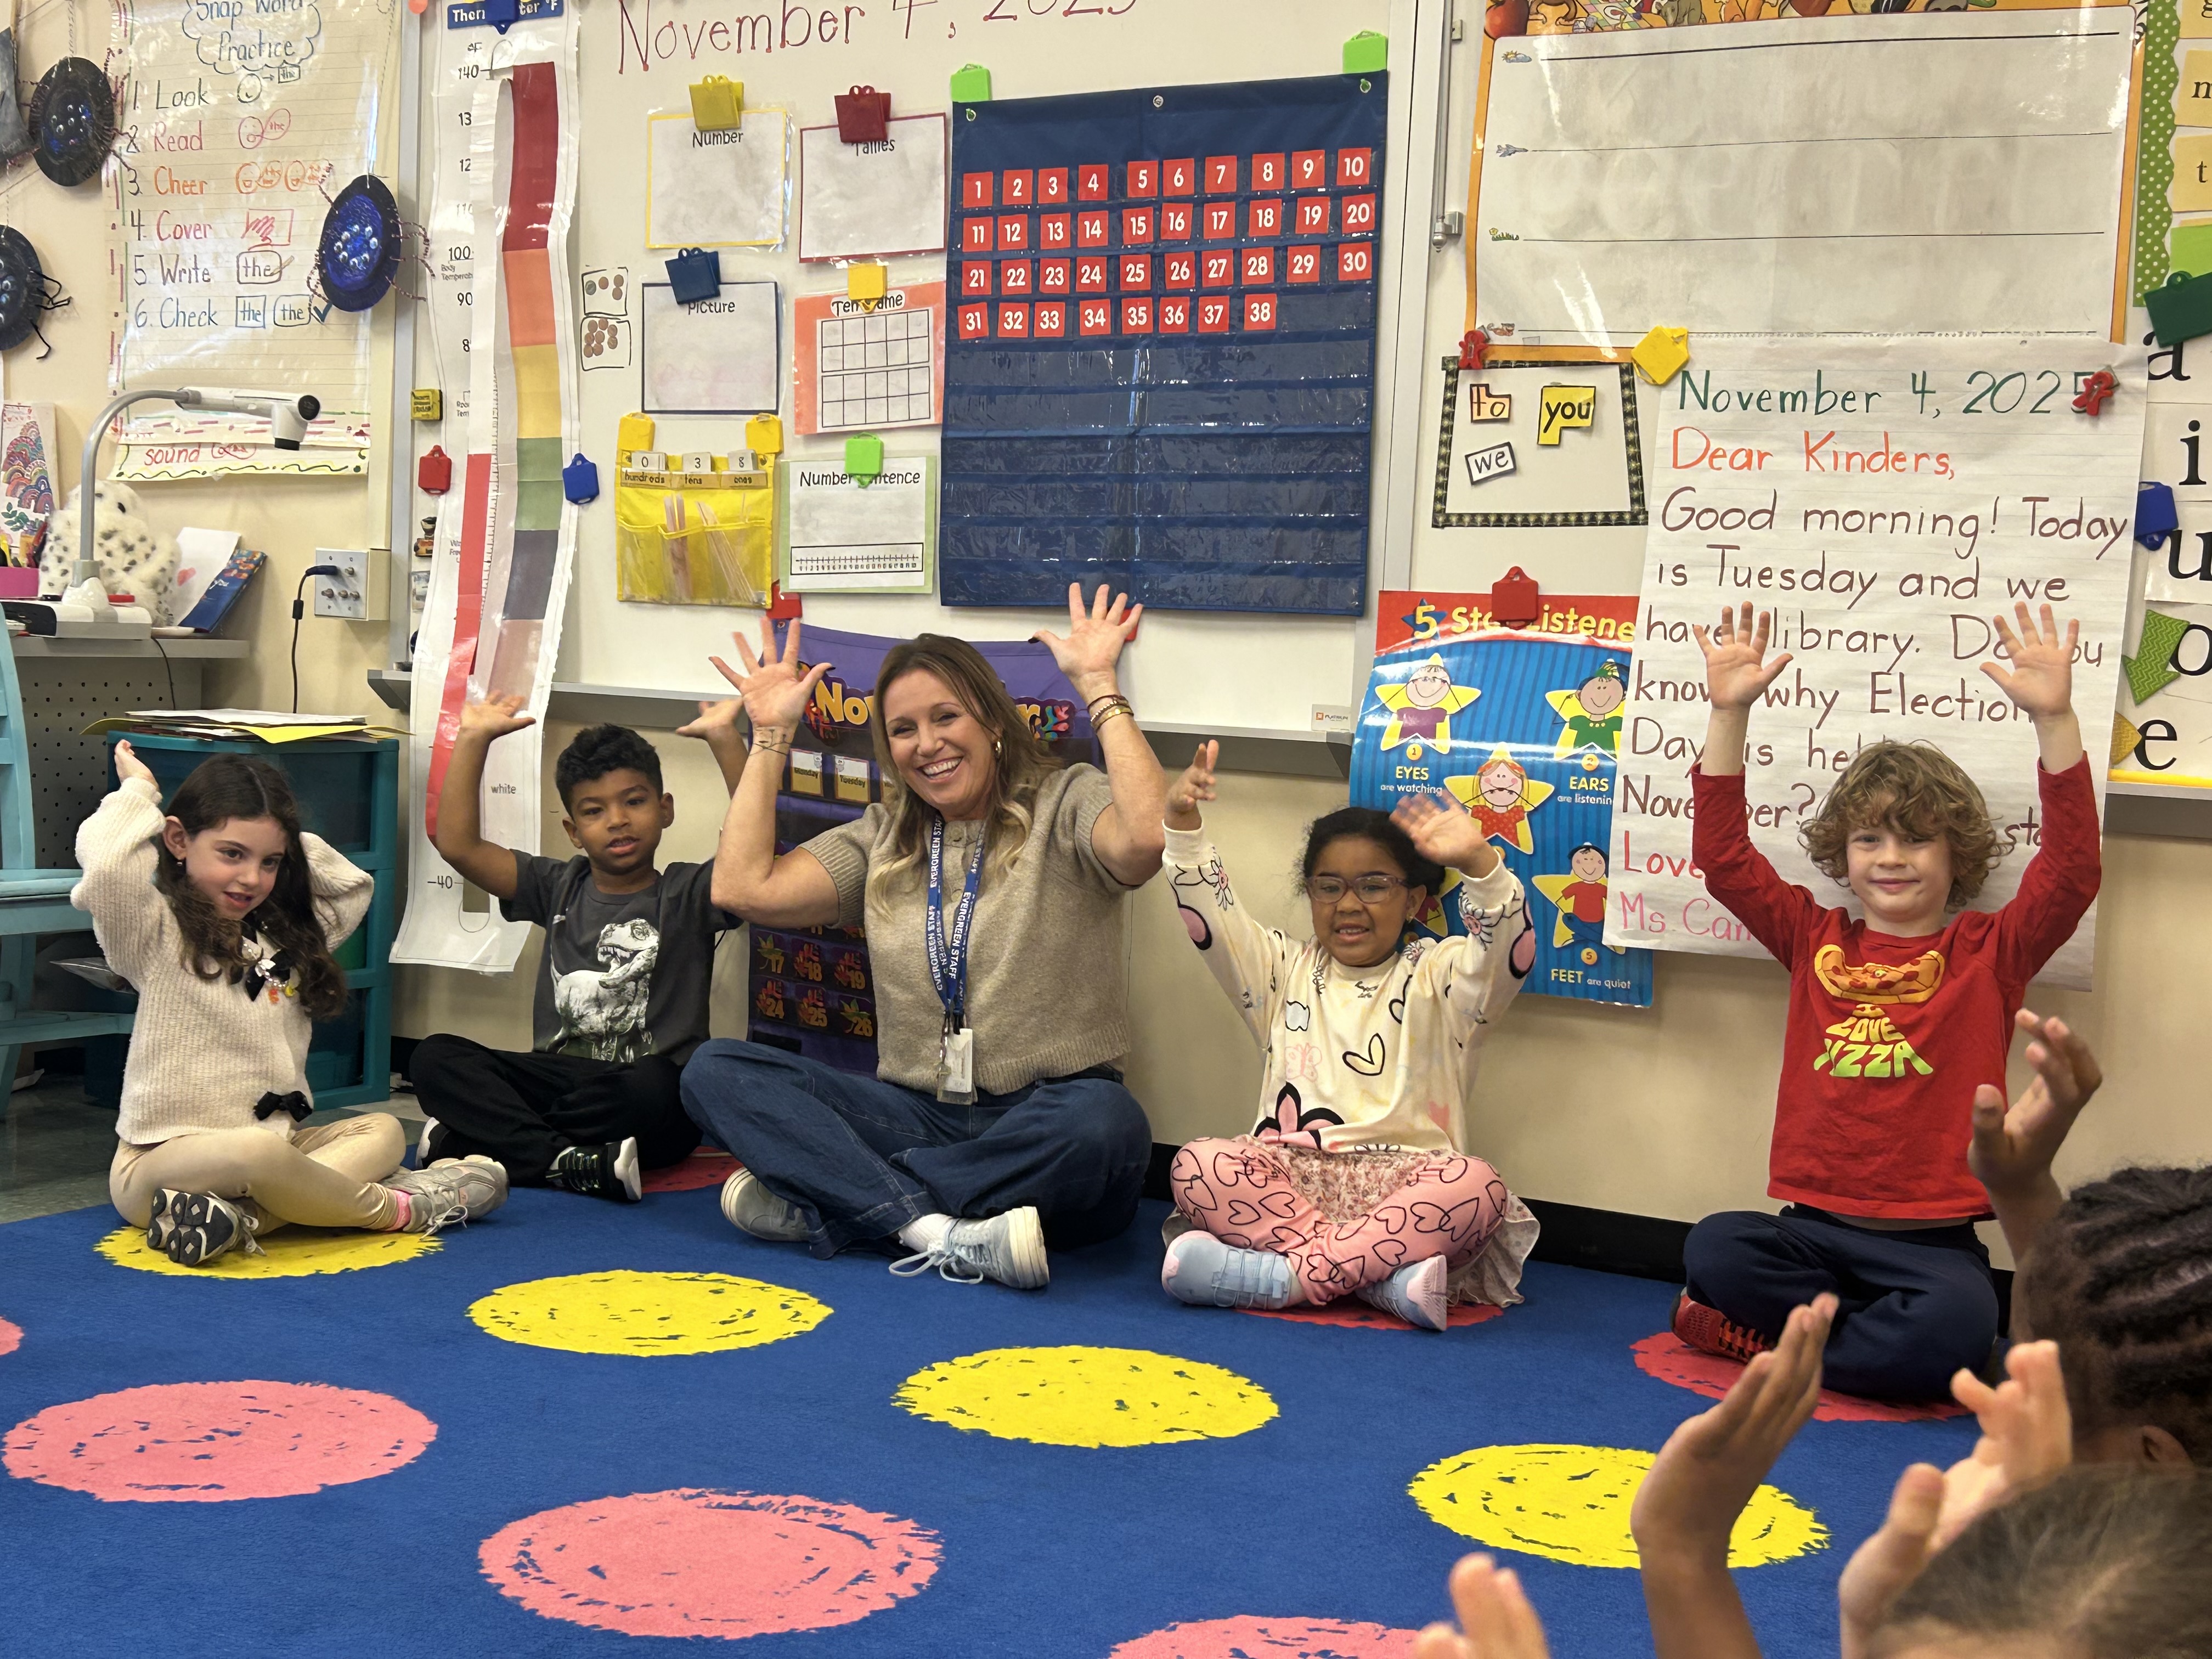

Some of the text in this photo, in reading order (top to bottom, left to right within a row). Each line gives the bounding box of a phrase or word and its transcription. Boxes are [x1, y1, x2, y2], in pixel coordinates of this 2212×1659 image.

[196, 0, 243, 30] Snap
[218, 30, 296, 61] Practice
[619, 0, 865, 74] November
[458, 65, 479, 80] 140
[156, 78, 210, 110] Look
[459, 112, 472, 127] 13
[154, 120, 204, 152] Read
[692, 130, 744, 148] Number
[460, 159, 472, 172] 12
[975, 156, 1364, 199] 1 2 3 4 5 6 7 8 9 10
[2196, 160, 2210, 184] t
[154, 166, 208, 196] Cheer
[156, 210, 213, 241] Cover
[972, 203, 1370, 244] 11 12 13 14 15 16 17 18 19 20
[242, 257, 272, 278] the
[449, 245, 472, 261] 100
[159, 253, 211, 286] Write
[969, 251, 1367, 287] 21 22 23 24 25 26 27 28 29 30
[135, 297, 219, 329] 6. Check
[240, 300, 262, 323] the
[280, 303, 306, 321] the
[457, 291, 473, 306] 90
[688, 301, 736, 315] Picture
[832, 294, 903, 318] Ten ame
[966, 302, 1271, 331] 31 32 33 34 35 36 37 38
[462, 338, 471, 352] 8
[2143, 331, 2192, 381] a
[1678, 369, 1882, 416] November
[1911, 373, 1941, 419] 4,
[1472, 386, 1591, 434] to you
[144, 442, 201, 466] sound
[641, 455, 649, 467] 0
[694, 456, 701, 469] 3
[738, 456, 744, 469] 8
[1474, 449, 1509, 474] we
[1671, 426, 1956, 480] Dear Kinders,
[2179, 420, 2207, 486] i
[799, 471, 921, 487] Number ntence
[1661, 486, 2129, 561] Good morning! Today
[2166, 528, 2212, 582] u
[1658, 544, 2071, 610] is Tuesday and we
[1414, 604, 1438, 640] 5
[1772, 607, 1921, 673] library.
[2169, 623, 2212, 676] o
[1764, 668, 1841, 730] why
[1632, 716, 1886, 778] Day is hel
[2133, 715, 2177, 770] e
[1395, 765, 1429, 781] EYES
[1569, 776, 1609, 792] EARS
[490, 783, 517, 795] white
[1396, 783, 1443, 797] watching
[1557, 794, 1573, 803] are
[1622, 774, 1816, 828] Noveer?
[1620, 891, 1666, 933] Ms
[948, 948, 960, 980] STAFF
[1585, 952, 1593, 961] 5
[806, 961, 823, 982] 18
[851, 969, 866, 990] 19
[1550, 968, 1632, 990] FEET are quiet
[766, 997, 874, 1038] 24 25 26
[1825, 1017, 1905, 1042] LOVE
